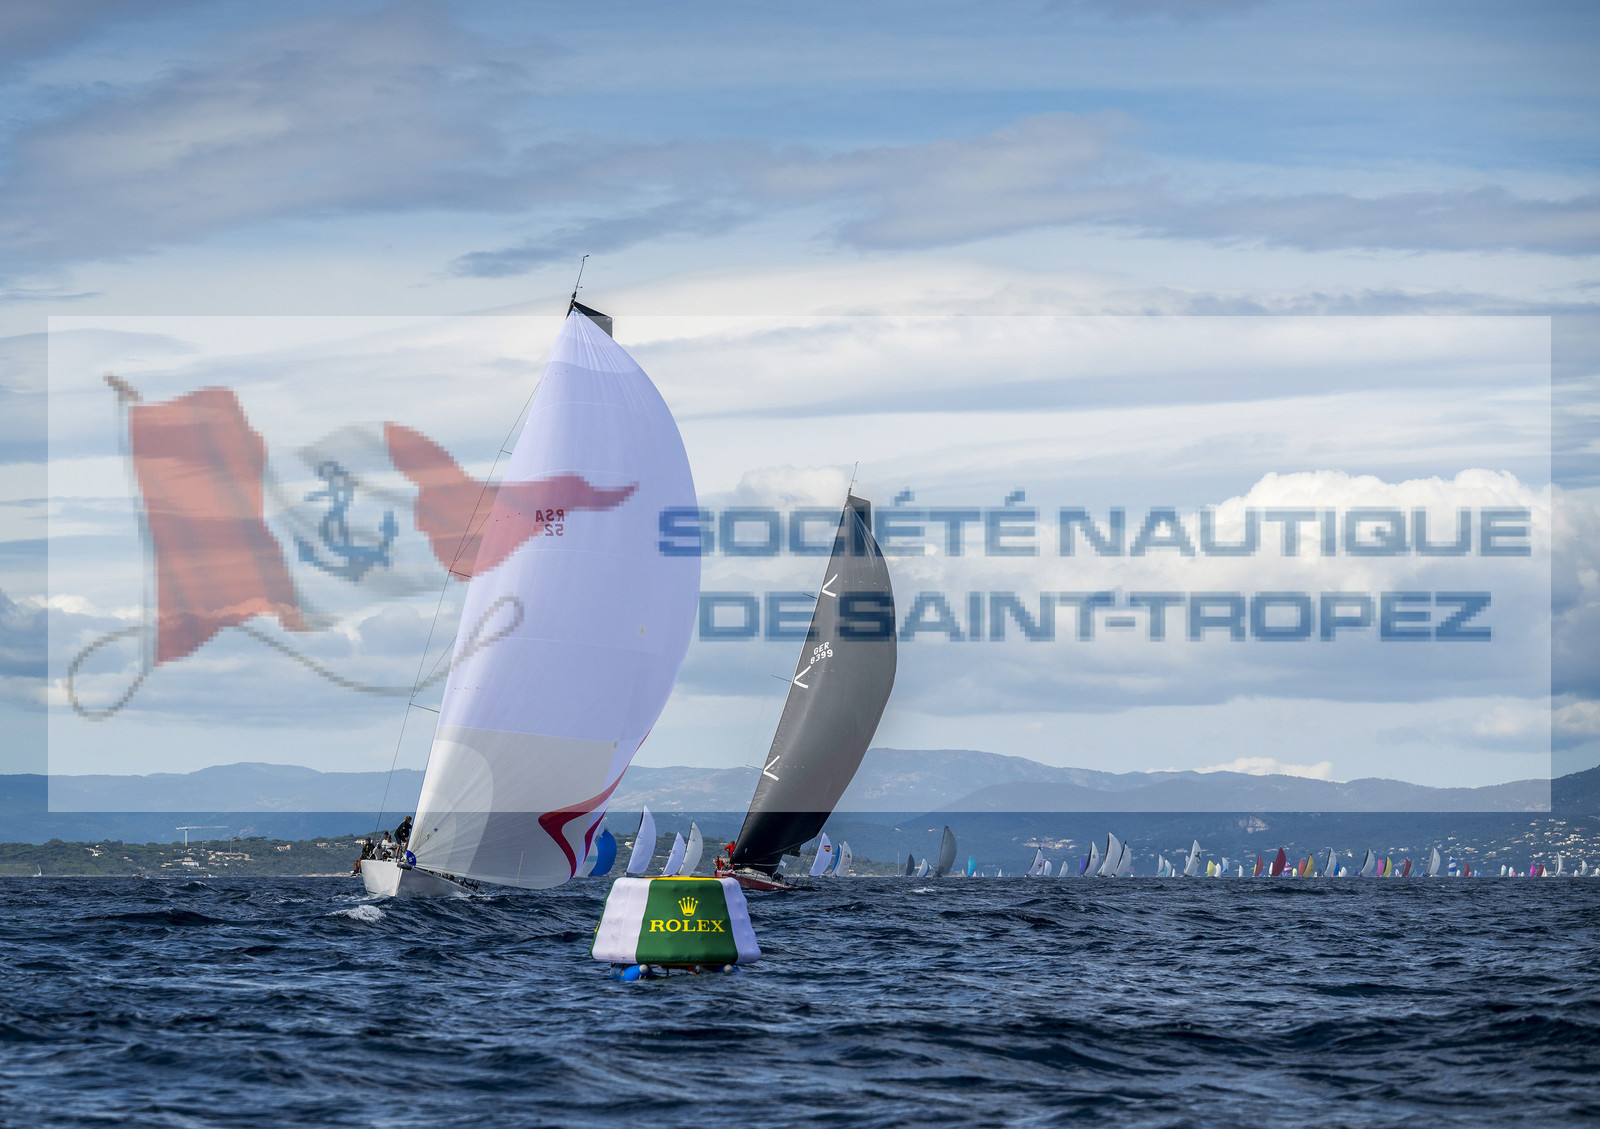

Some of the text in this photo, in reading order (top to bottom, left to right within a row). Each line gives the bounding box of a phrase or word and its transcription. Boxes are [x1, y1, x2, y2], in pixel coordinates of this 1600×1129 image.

[813, 641, 830, 655] GER
[810, 649, 833, 665] 8399
[649, 918, 725, 932] ROLEX
